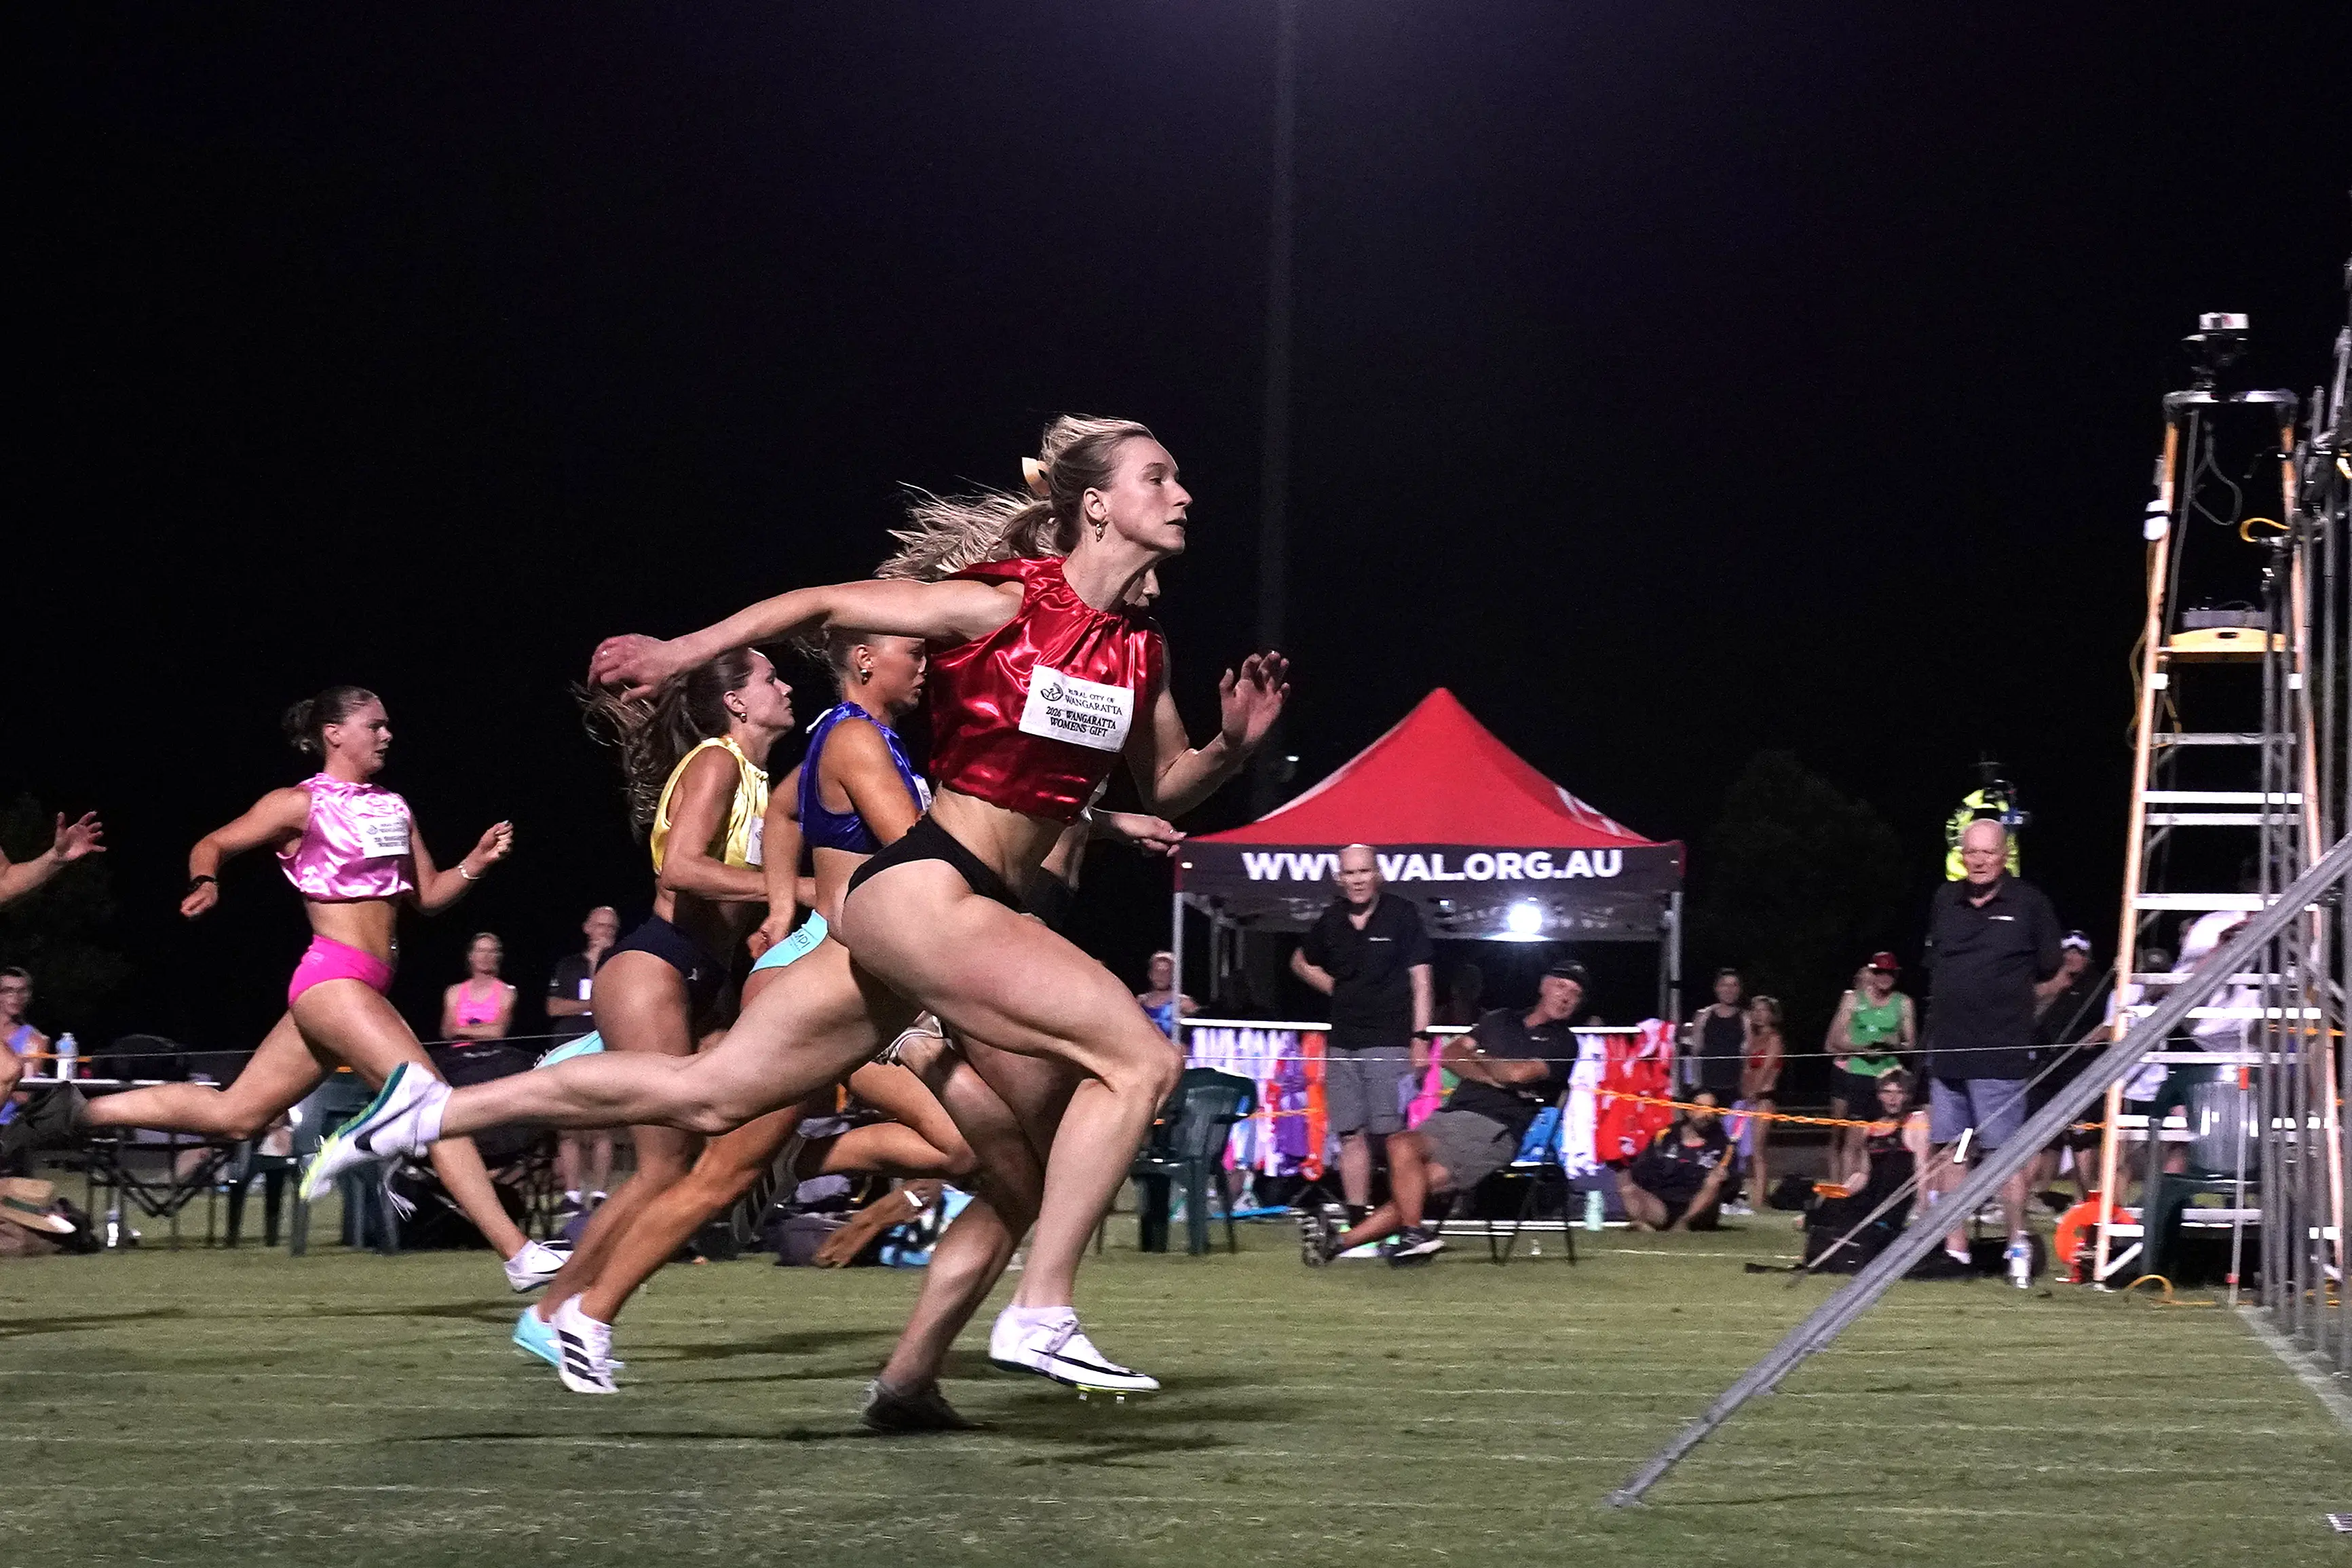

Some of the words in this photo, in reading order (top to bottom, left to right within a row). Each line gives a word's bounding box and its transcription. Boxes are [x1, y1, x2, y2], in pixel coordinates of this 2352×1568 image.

[1065, 694, 1123, 716] WANGARATTA
[1046, 706, 1065, 717] 2026
[1066, 710, 1116, 729] WANGARATTA
[1050, 716, 1086, 733] WOMENS
[1089, 725, 1108, 738] GIFT
